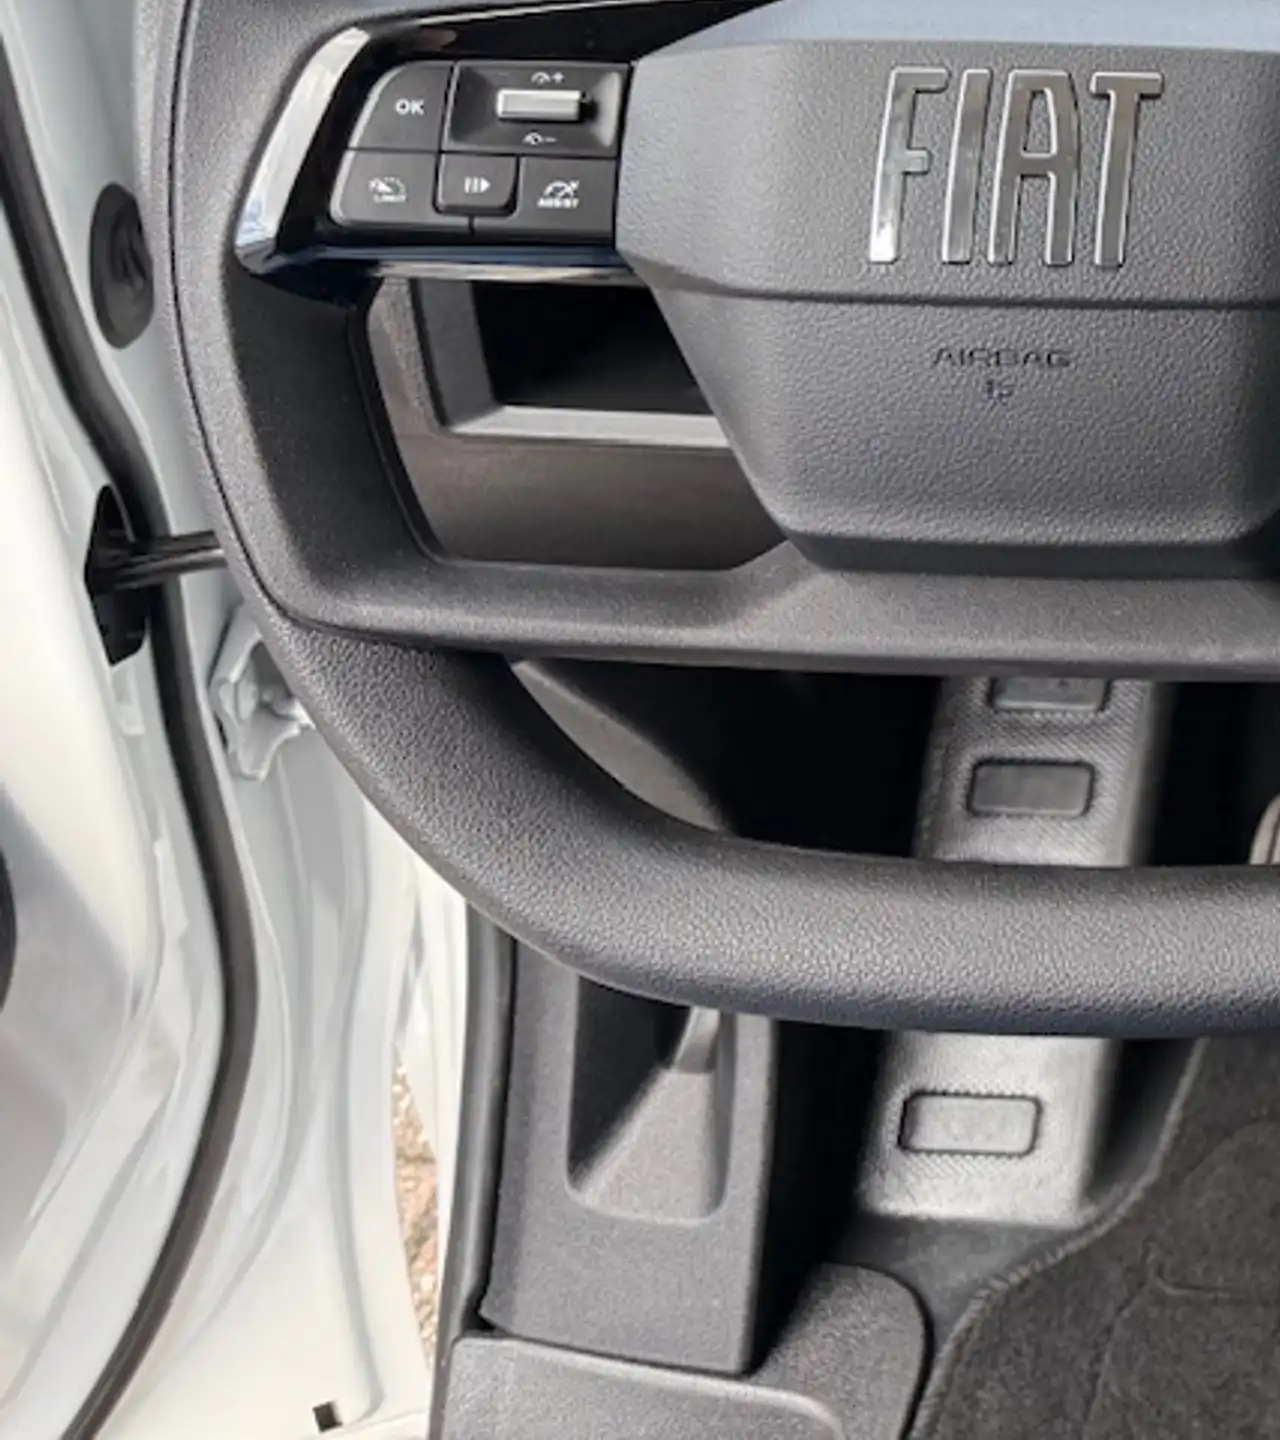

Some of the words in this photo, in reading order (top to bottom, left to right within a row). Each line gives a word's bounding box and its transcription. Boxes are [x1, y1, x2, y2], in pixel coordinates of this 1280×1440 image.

[395, 97, 425, 116] OK
[869, 68, 1164, 267] FIAT
[932, 348, 1072, 368] AIRBAG
